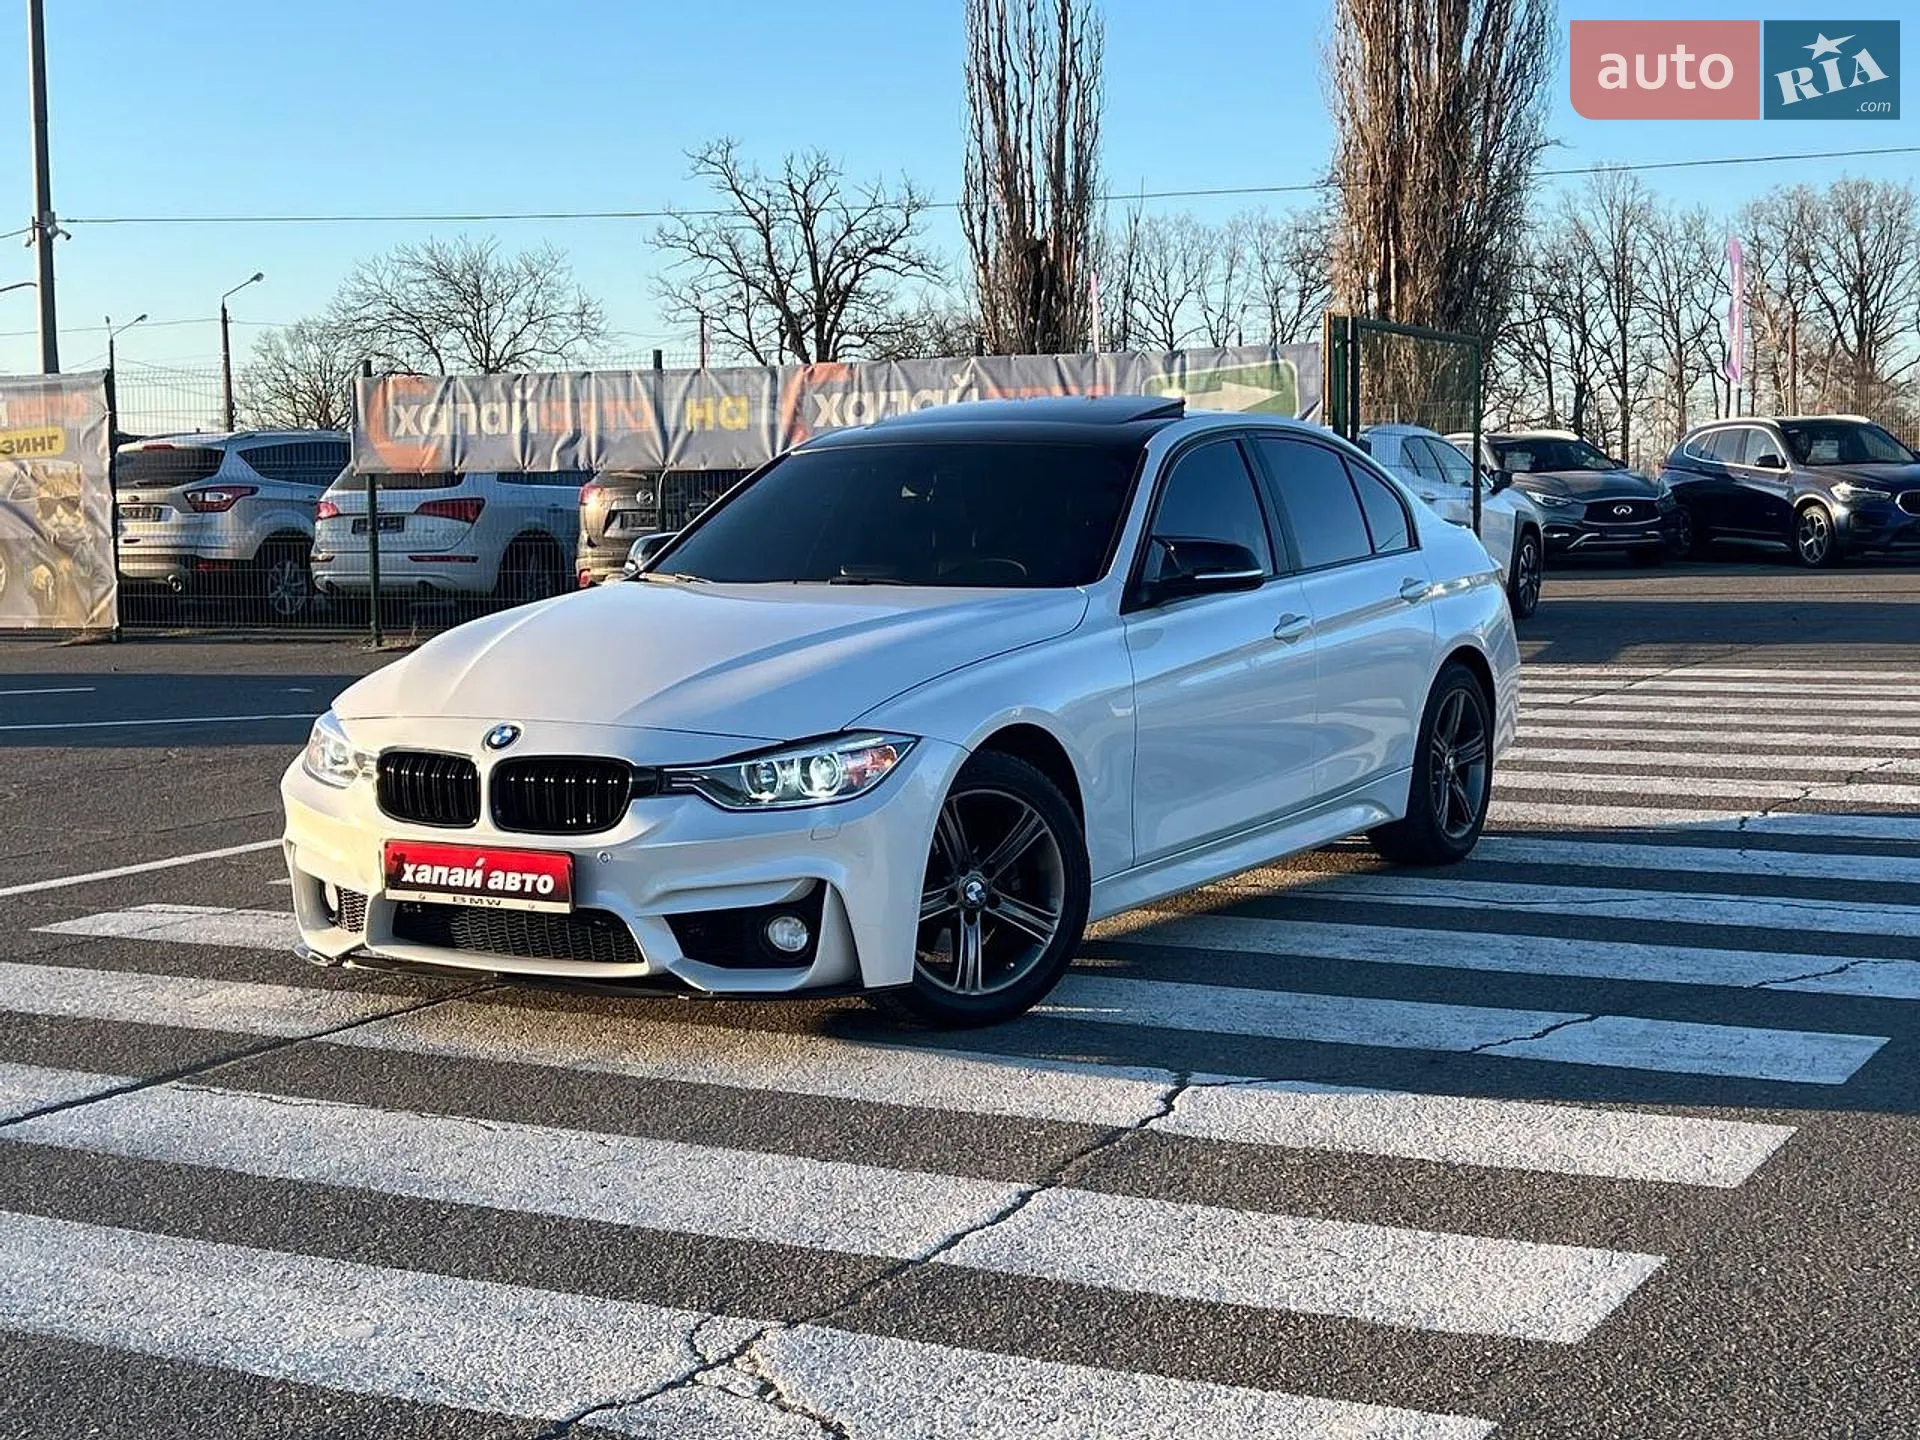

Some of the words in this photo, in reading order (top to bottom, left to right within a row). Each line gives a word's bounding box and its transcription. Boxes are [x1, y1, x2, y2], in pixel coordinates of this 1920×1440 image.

[686, 395, 748, 431] на
[487, 870, 555, 894] авто
[452, 896, 502, 906] BMW
